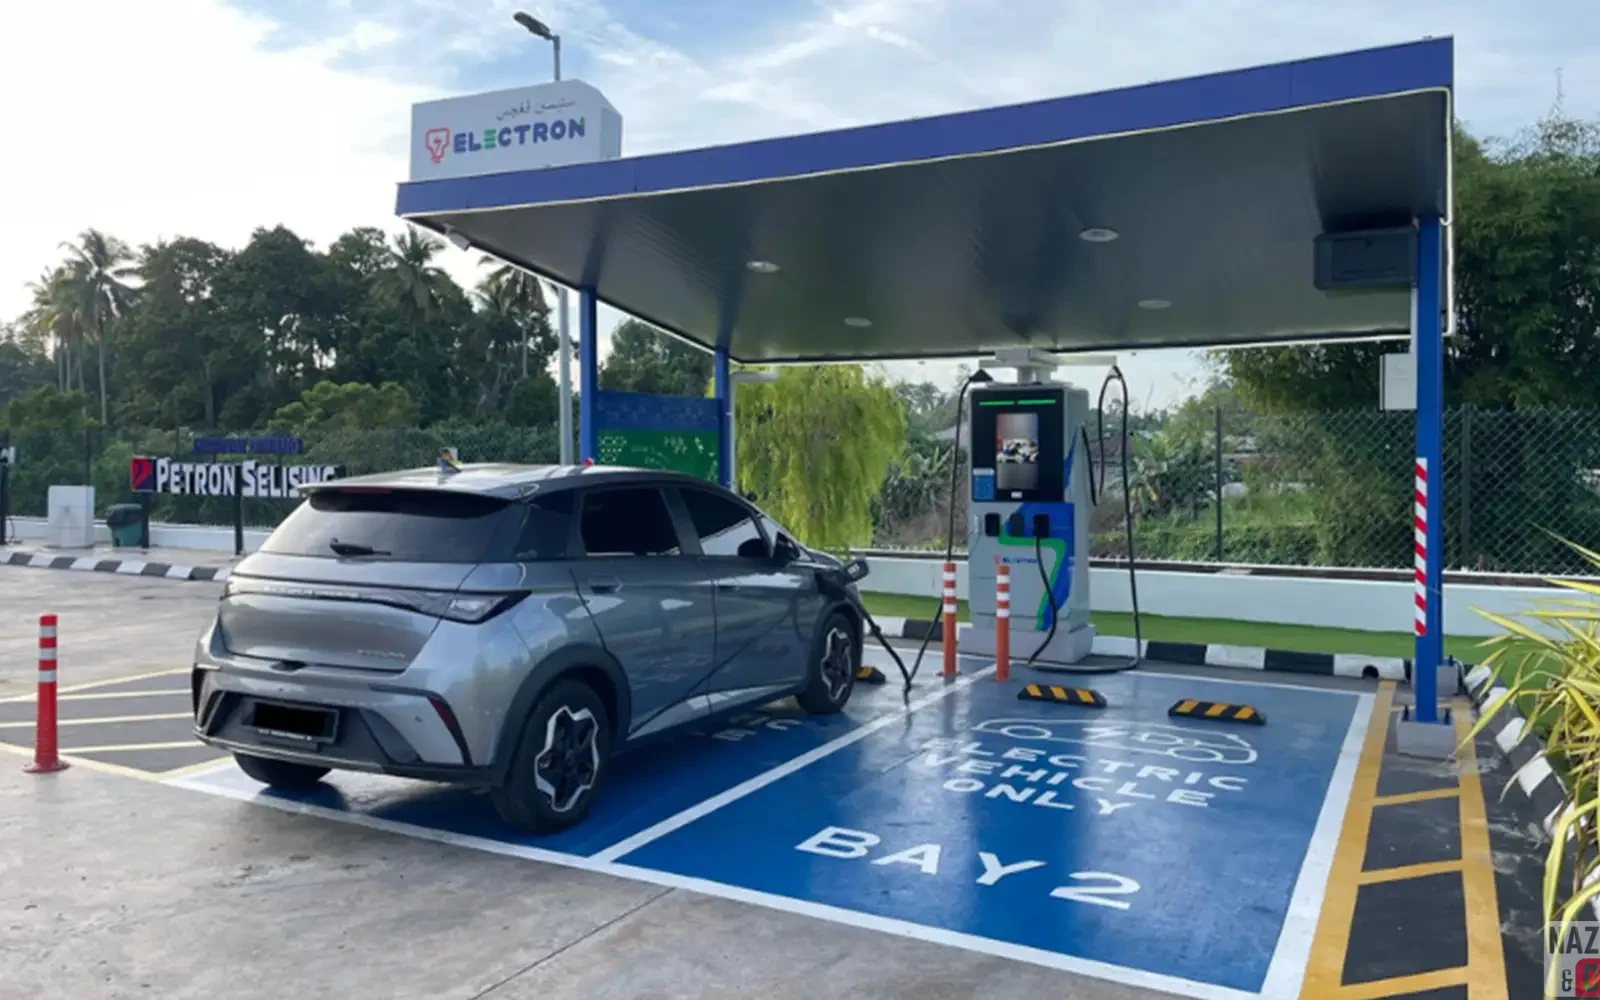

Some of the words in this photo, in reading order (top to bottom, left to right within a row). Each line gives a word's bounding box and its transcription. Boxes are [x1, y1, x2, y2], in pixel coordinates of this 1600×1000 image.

[453, 116, 586, 154] ELECTRON
[156, 458, 236, 496] PETRON
[921, 737, 1249, 791] ELECTRIC
[921, 751, 1216, 808] VEHICLE
[942, 778, 1136, 815] ONLY
[794, 826, 1047, 886] BAY
[1049, 871, 1141, 910] 2
